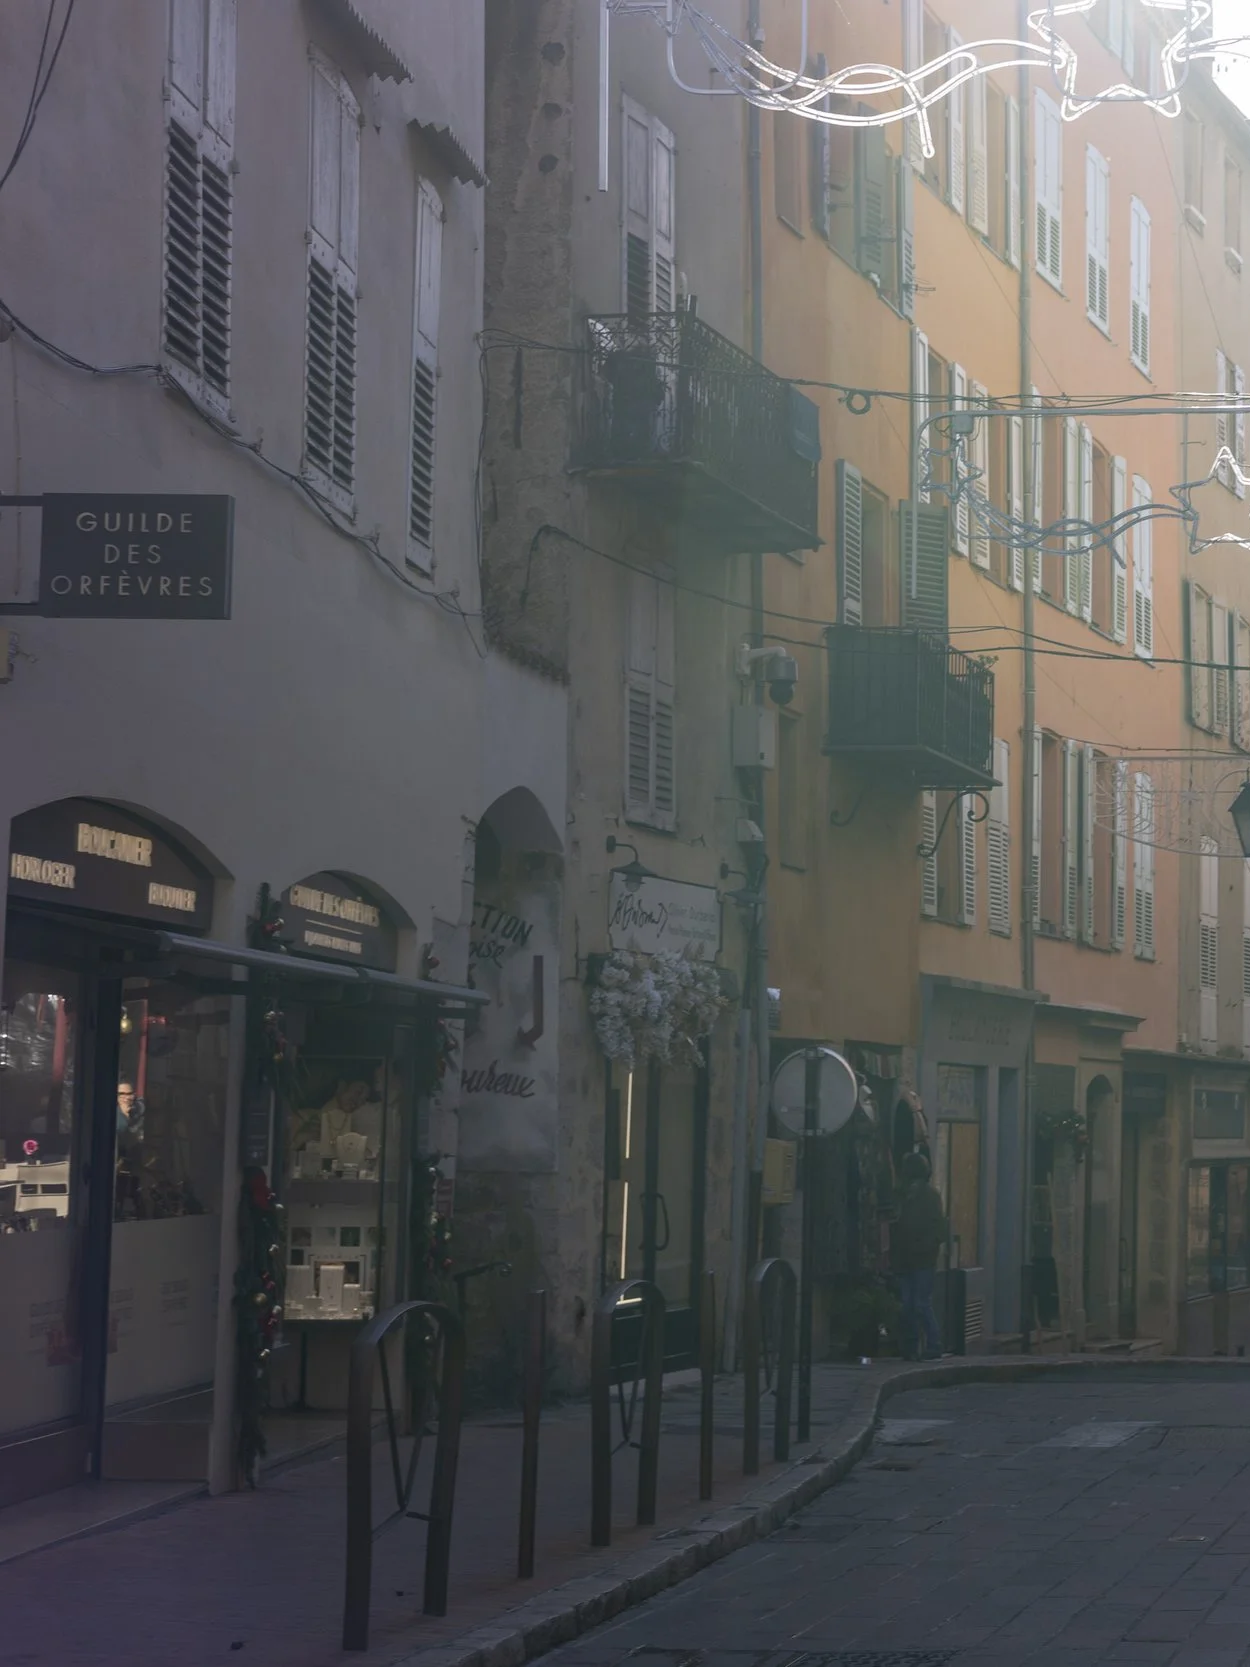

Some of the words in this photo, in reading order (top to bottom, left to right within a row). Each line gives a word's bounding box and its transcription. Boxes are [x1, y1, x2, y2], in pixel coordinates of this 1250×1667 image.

[76, 512, 193, 533] GUILDE
[104, 544, 162, 564] DES
[51, 570, 213, 596] ORFÈVRES
[472, 901, 534, 947] TION
